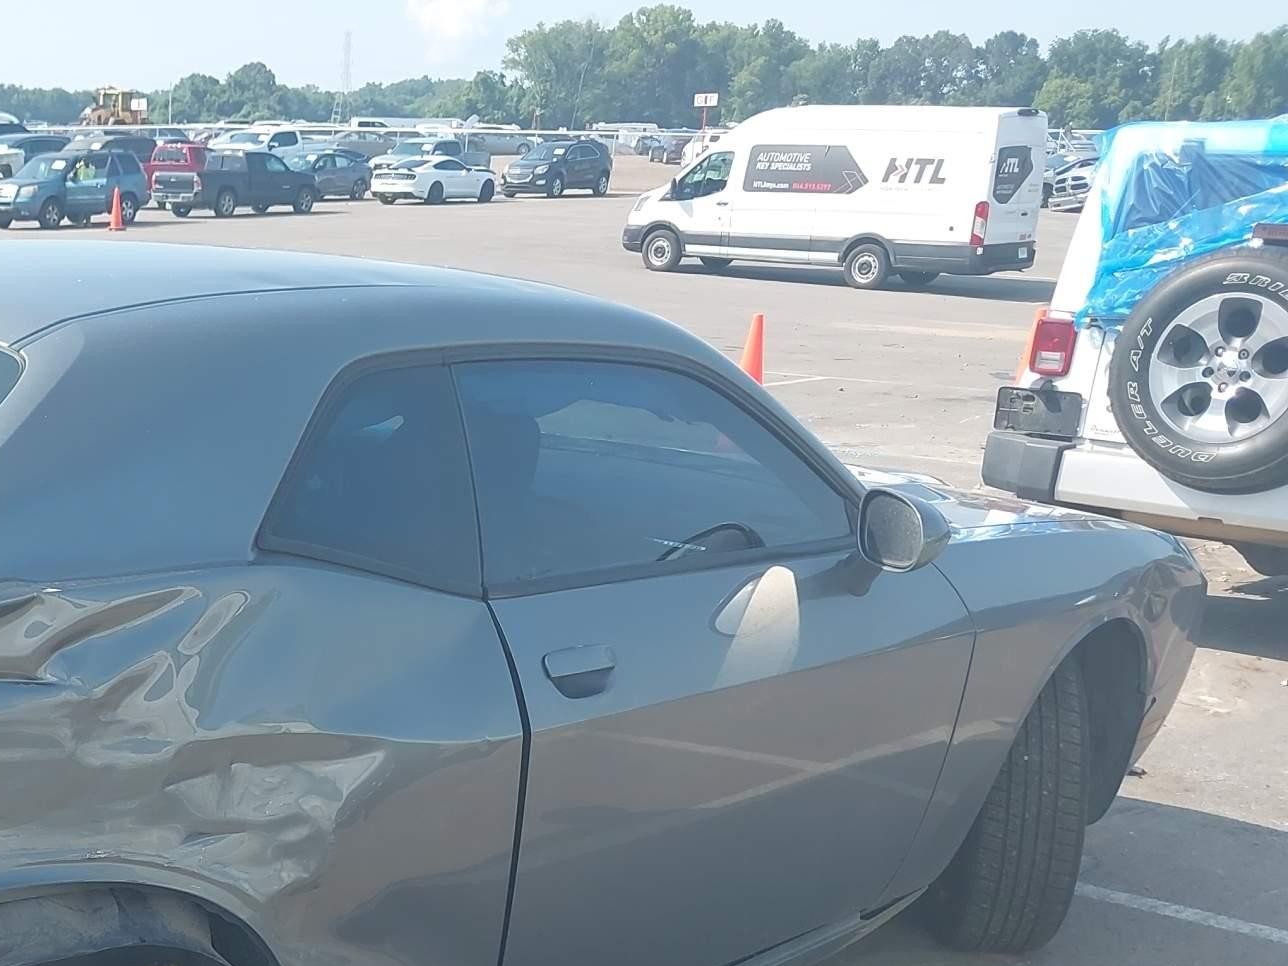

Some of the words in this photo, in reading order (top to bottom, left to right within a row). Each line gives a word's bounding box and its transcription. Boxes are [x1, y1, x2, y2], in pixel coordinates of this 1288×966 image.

[756, 162, 770, 170] KEY
[770, 163, 812, 171] SPECIALISTS
[757, 152, 812, 163] AUTOMOTIVE
[881, 157, 946, 184] HTL
[1130, 317, 1153, 372] A/T
[1127, 381, 1216, 462] DUELER
